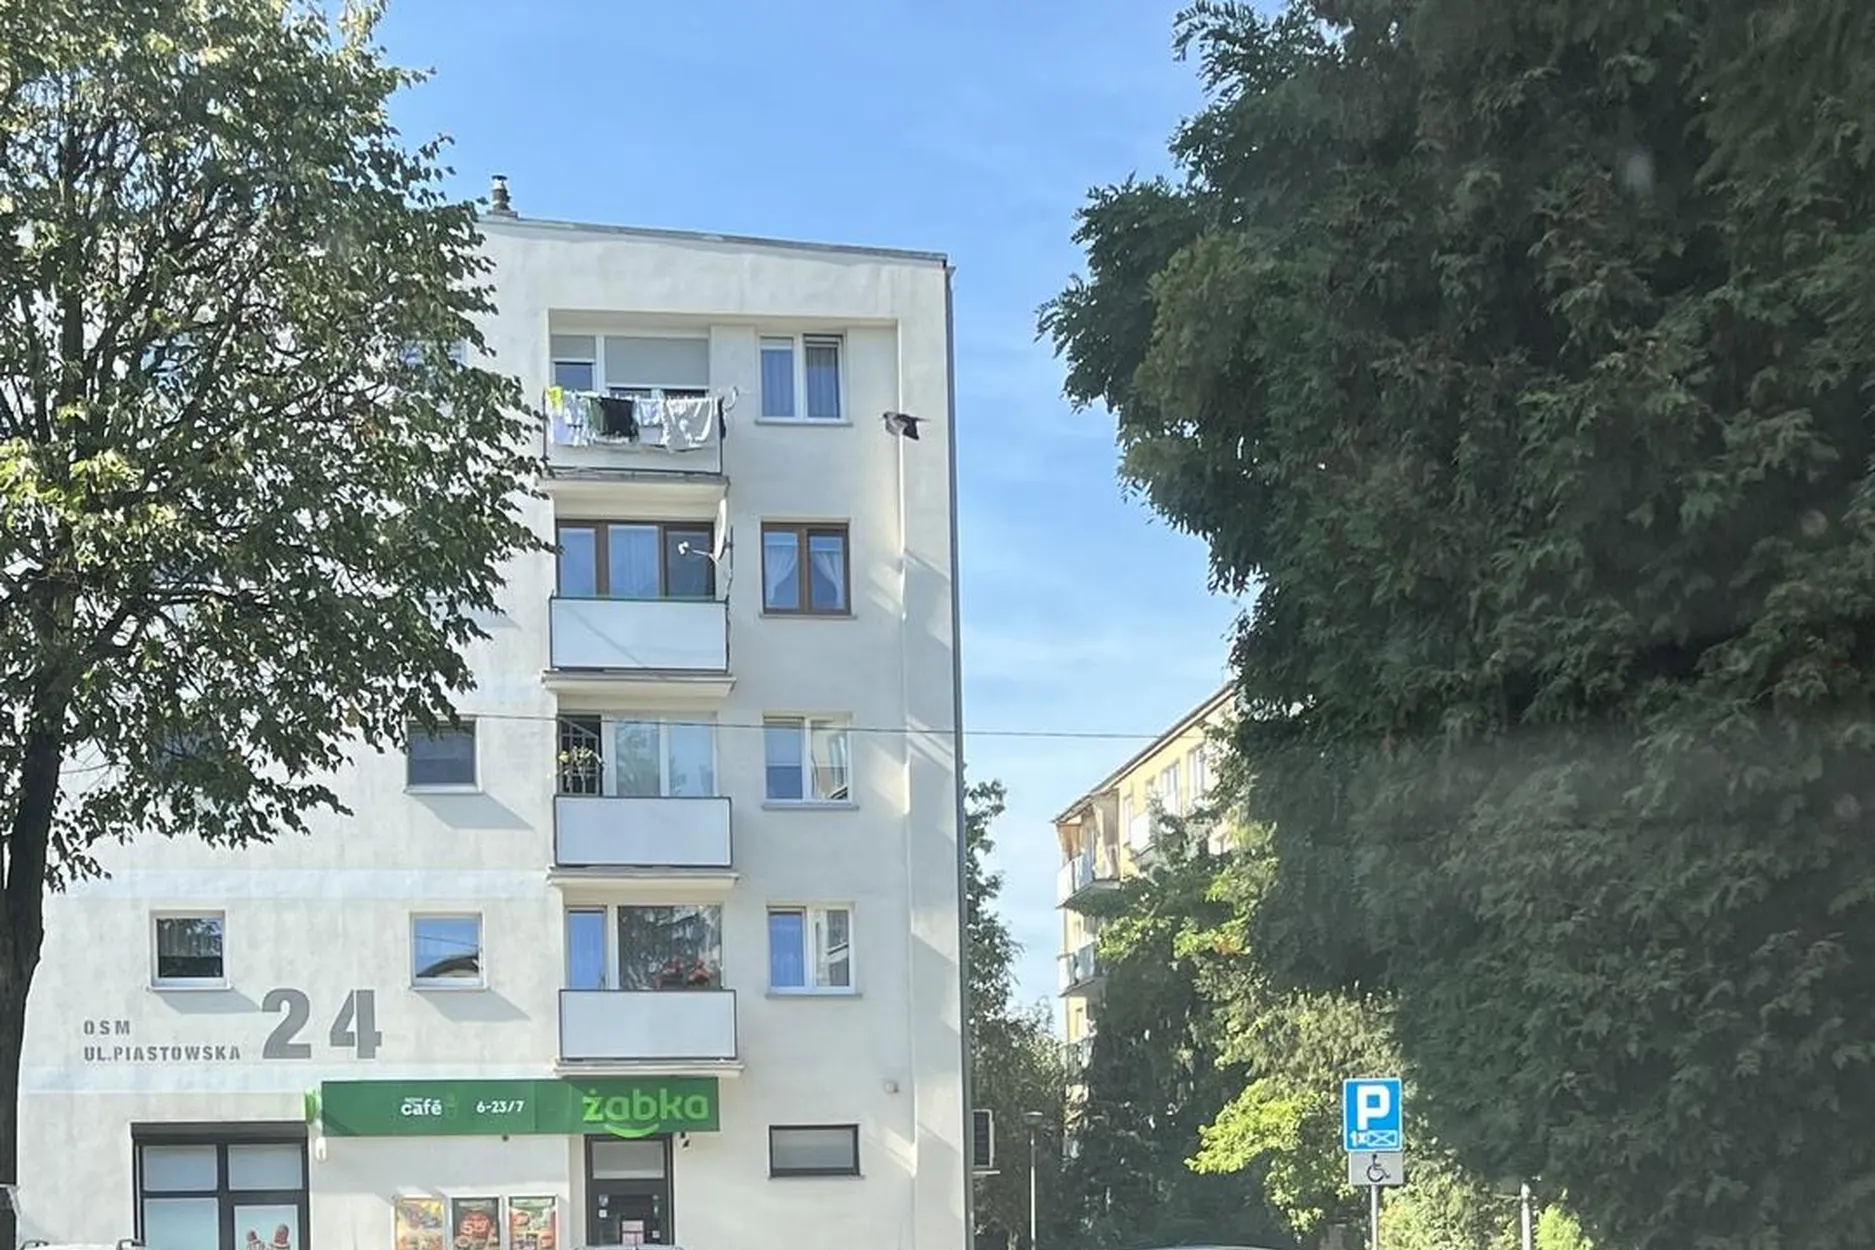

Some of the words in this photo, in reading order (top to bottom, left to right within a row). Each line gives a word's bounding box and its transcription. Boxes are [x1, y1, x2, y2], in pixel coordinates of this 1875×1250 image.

[83, 1020, 131, 1036] OSM
[261, 988, 382, 1060] 24
[83, 1045, 241, 1062] UL.PIASTOWSKA
[476, 1100, 524, 1114] 6-23/7
[582, 1088, 709, 1121] żabka
[1357, 1085, 1390, 1131] P
